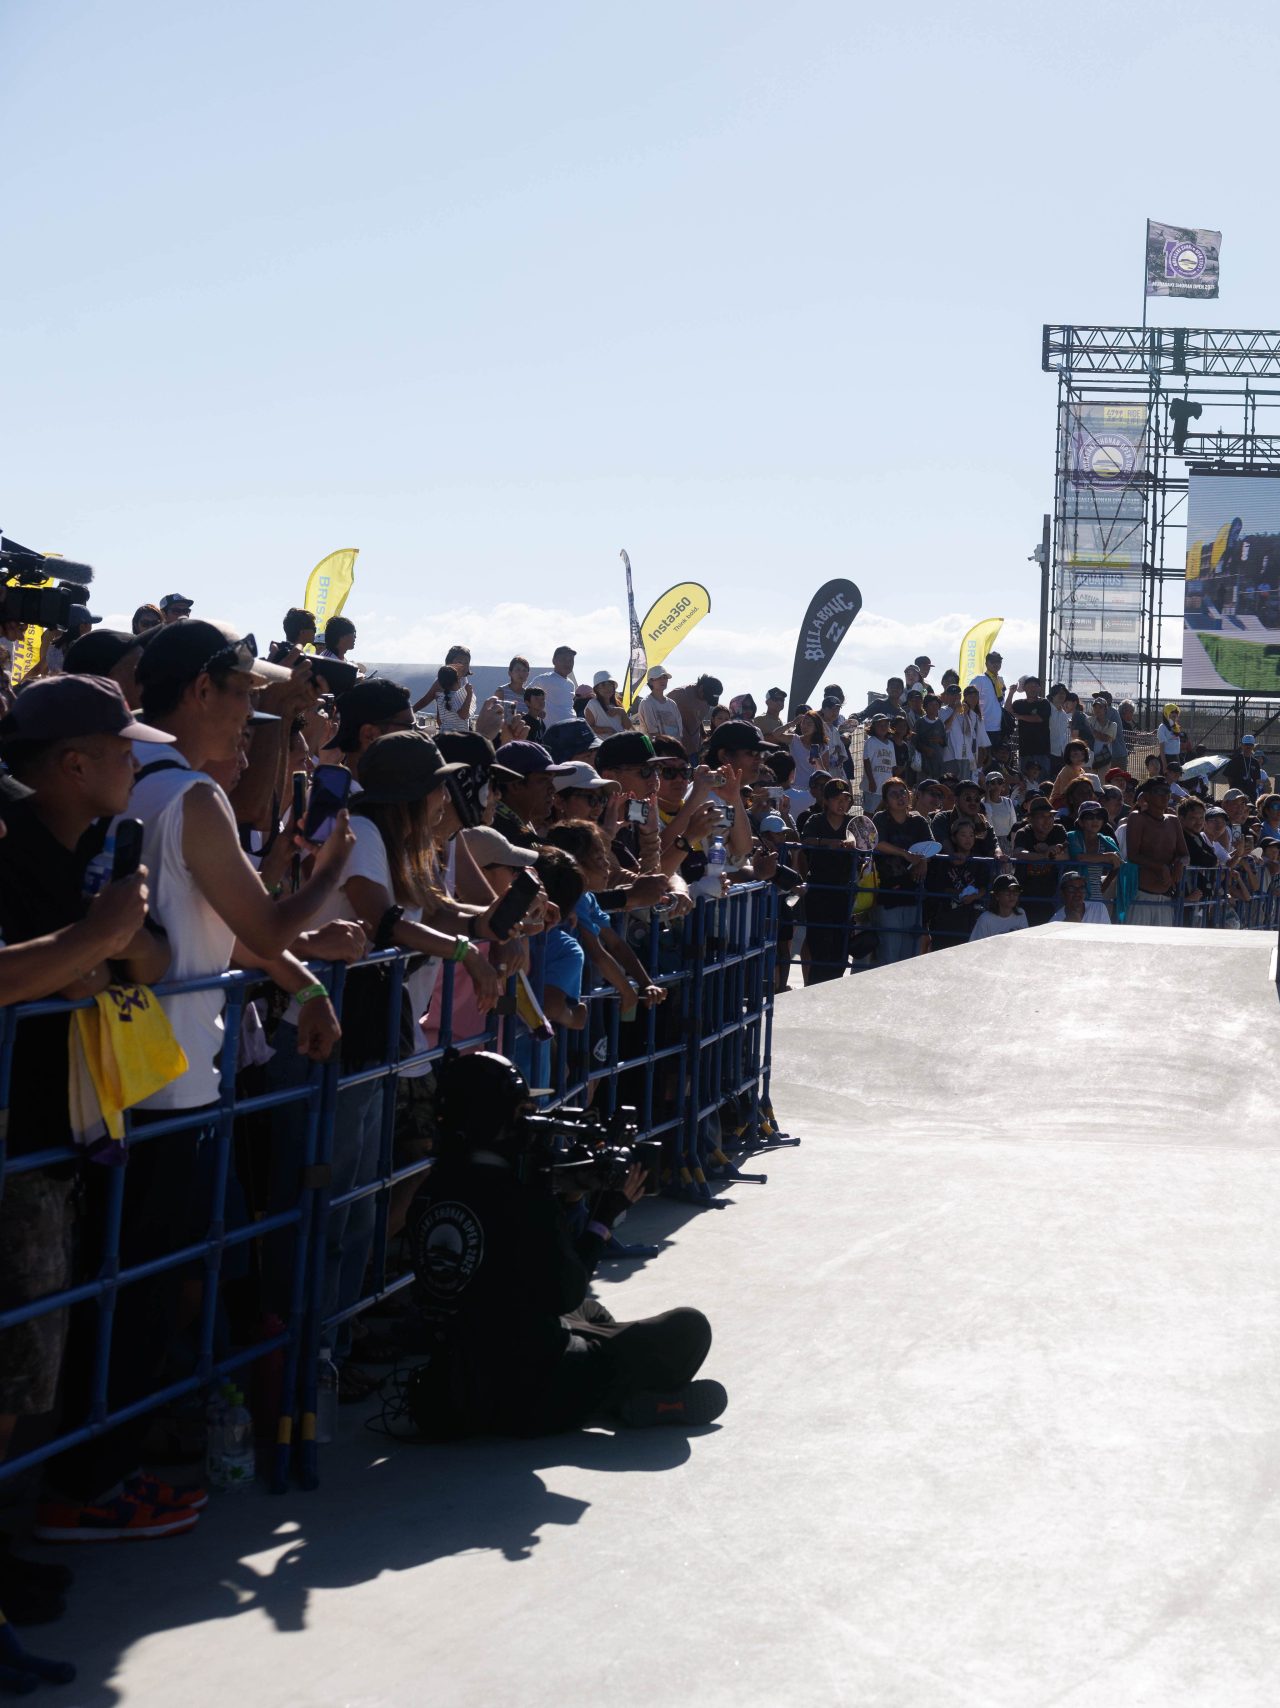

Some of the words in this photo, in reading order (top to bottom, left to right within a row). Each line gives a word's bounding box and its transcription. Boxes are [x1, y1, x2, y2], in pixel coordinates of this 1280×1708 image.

[648, 596, 692, 642] Insta360
[804, 592, 855, 661] BILLABONG
[1100, 652, 1129, 662] VANS
